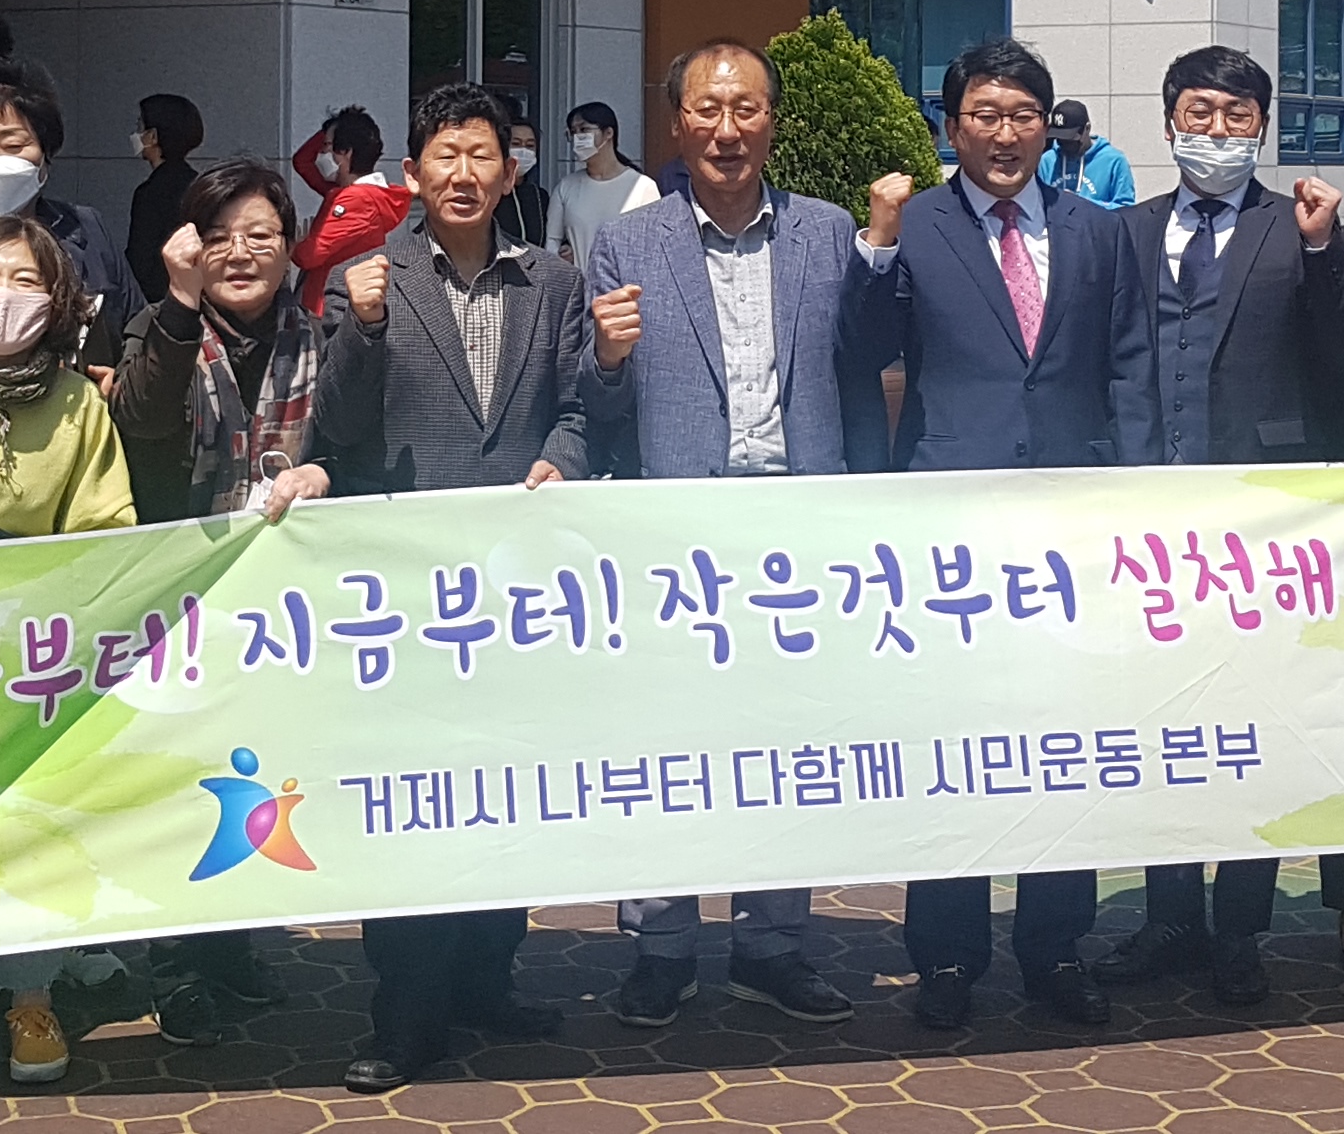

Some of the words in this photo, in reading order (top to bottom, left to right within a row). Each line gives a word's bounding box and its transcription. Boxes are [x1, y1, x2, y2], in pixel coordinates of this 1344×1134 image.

[238, 559, 622, 686] 지금부터!
[652, 543, 1077, 665] 작은것부터
[340, 767, 517, 835] 거제시
[538, 753, 713, 821] 나부터
[733, 742, 905, 809] 다함께
[927, 728, 1142, 797] 시민운동
[1161, 723, 1264, 786] 본부
